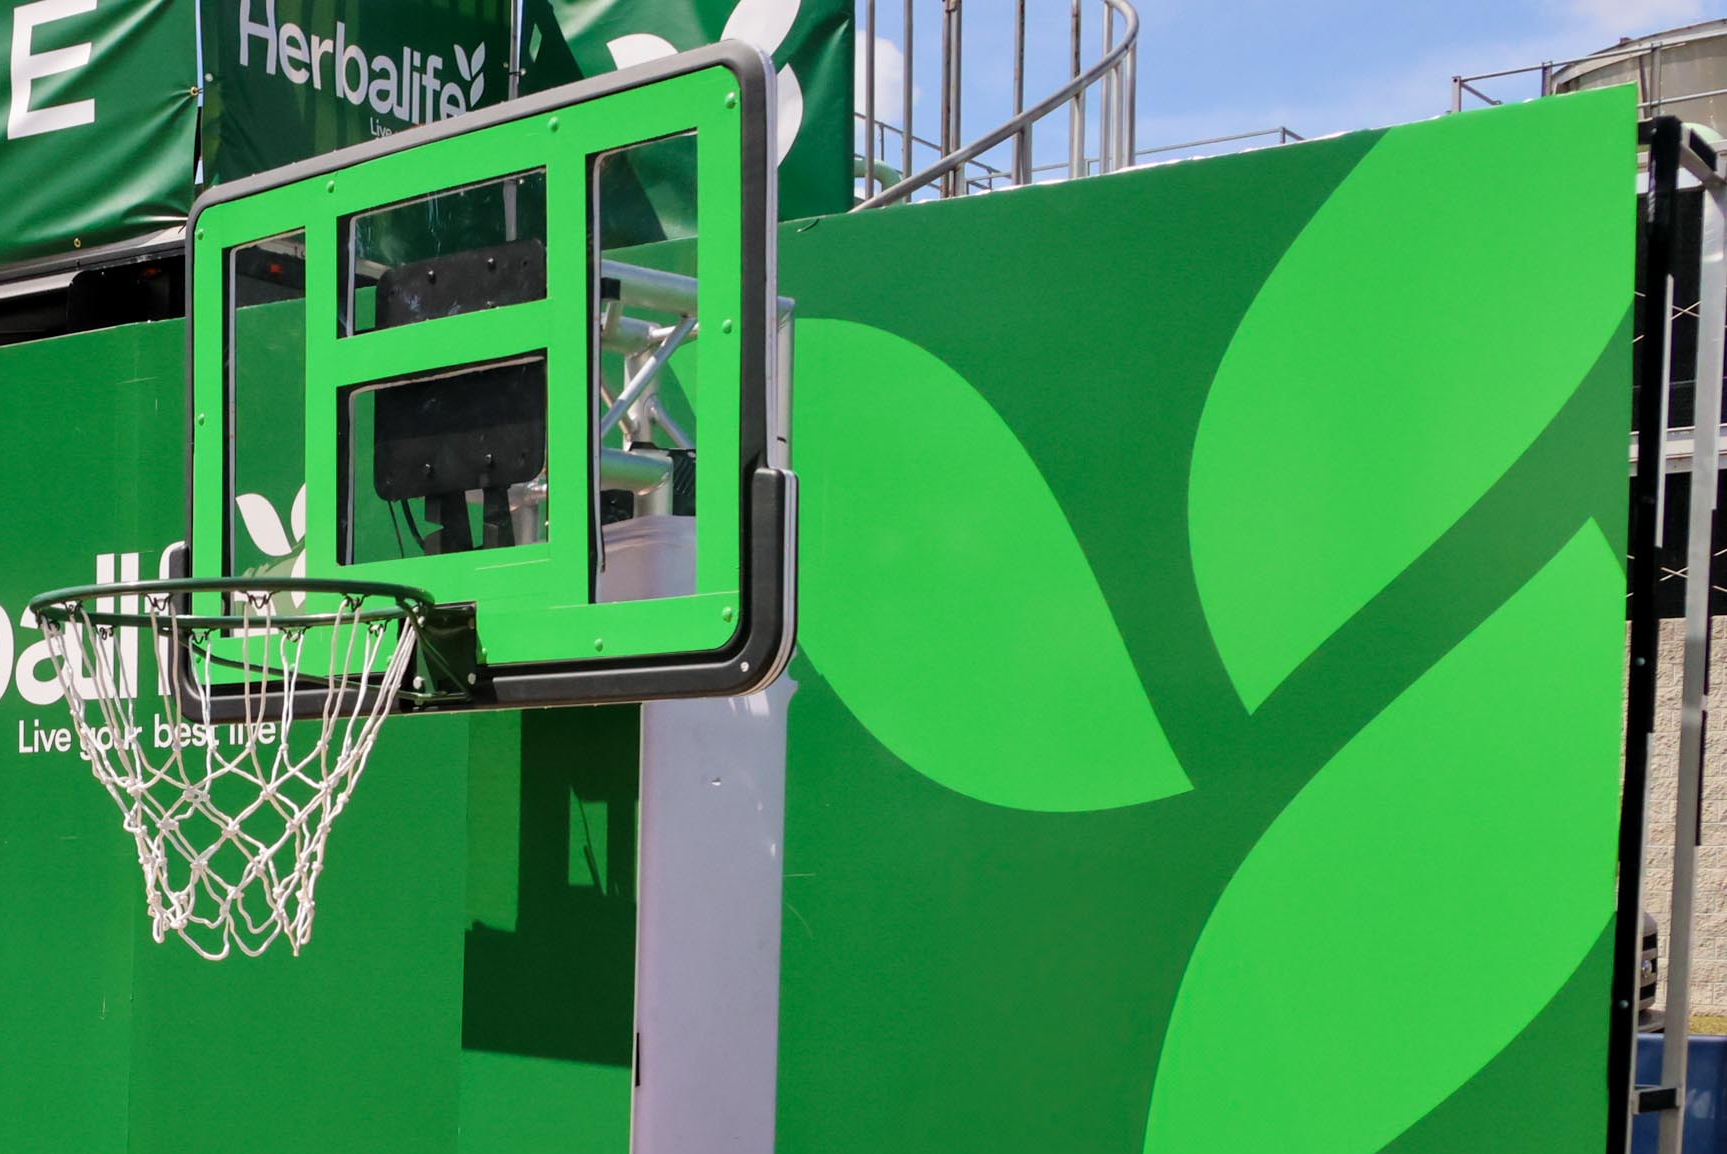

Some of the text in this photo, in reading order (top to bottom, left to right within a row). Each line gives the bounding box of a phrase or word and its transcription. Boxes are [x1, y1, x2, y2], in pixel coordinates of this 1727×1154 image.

[239, 0, 466, 125] Herbalife
[19, 719, 71, 754] Live
[154, 713, 219, 748] best
